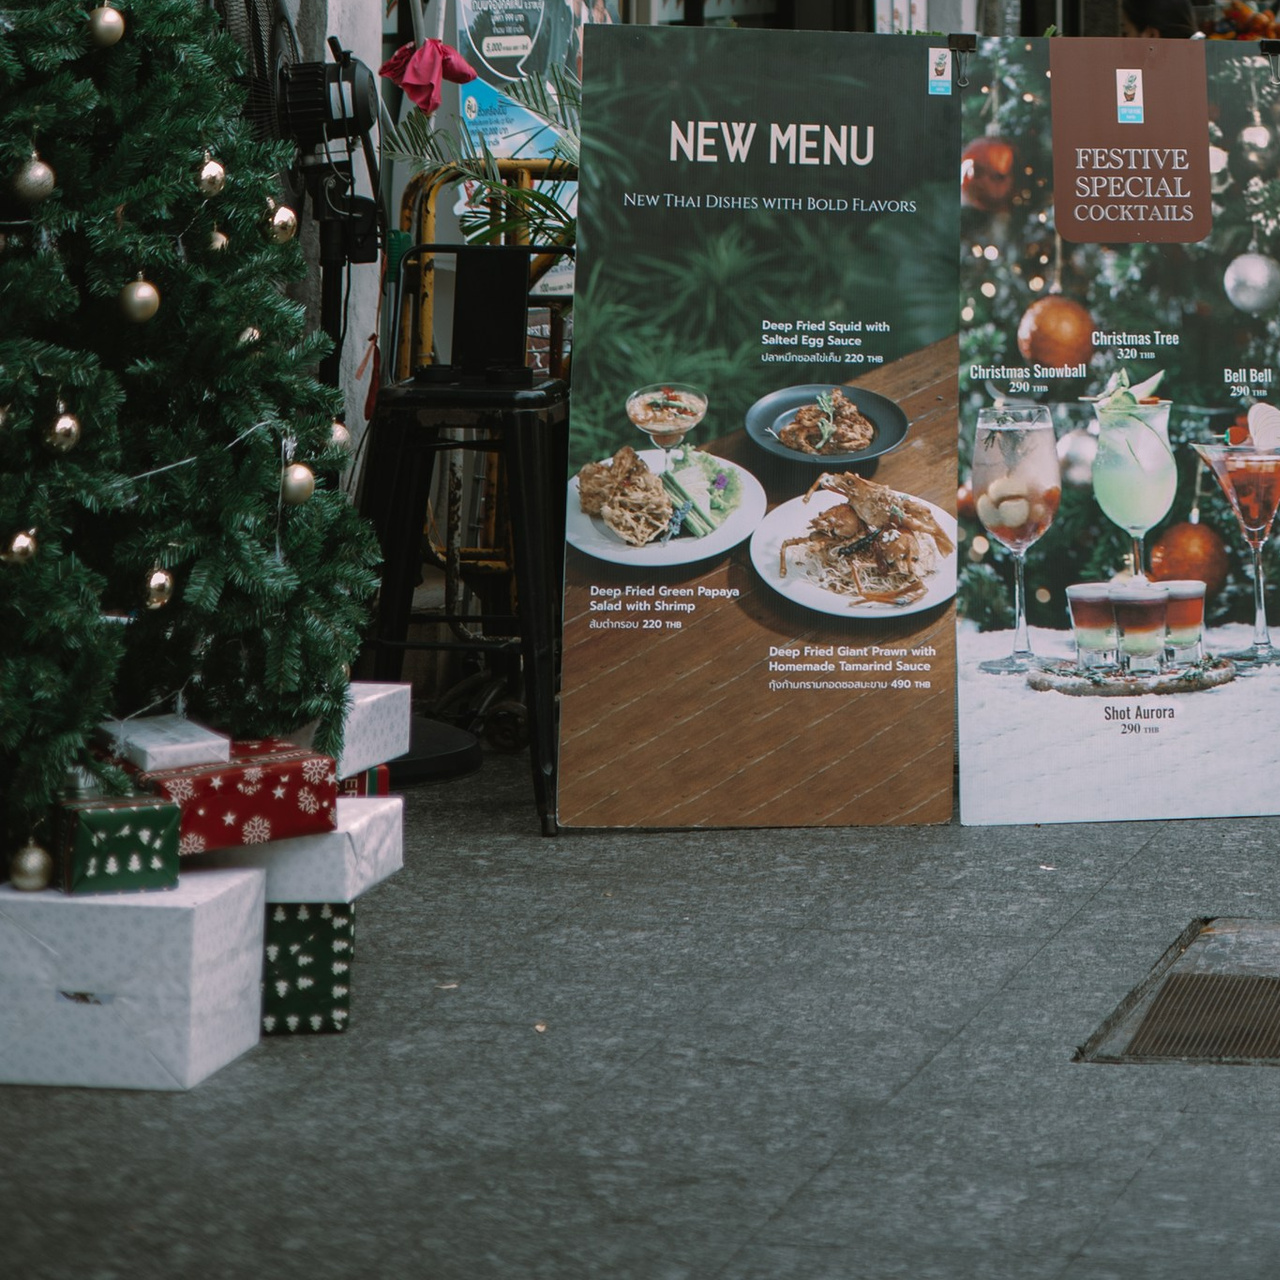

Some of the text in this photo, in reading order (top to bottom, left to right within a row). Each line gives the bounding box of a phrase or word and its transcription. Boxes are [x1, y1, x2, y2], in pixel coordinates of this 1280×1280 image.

[670, 120, 874, 166] NEW MENU
[1075, 148, 1190, 172] FESTIVE
[1075, 175, 1191, 200] SPECIAL
[623, 192, 917, 213] NEW THAI DISHES WITH BOLD FLAVORS
[1074, 203, 1194, 223] COCKTAILS
[762, 320, 890, 334] Deep Fried Squid with
[761, 334, 862, 348] Salted Egg Sauce
[1091, 330, 1179, 346] Christmas Tree
[844, 353, 865, 363] 220
[866, 355, 884, 364] THB
[1116, 348, 1156, 360] 320 THB
[969, 363, 1086, 380] Christmas Snowball
[1223, 368, 1272, 384] Bell Bell
[1008, 380, 1049, 393] 290 THB
[1229, 385, 1268, 397] 290 THB
[590, 585, 740, 599] Deep Fried Green Papaya
[589, 600, 696, 614] Salad with Shrimp
[589, 618, 682, 630] ส้มตำกรอบ 220 THB
[769, 646, 936, 658] Deep Fried Giant Prawn with
[768, 661, 931, 672] Homemade Tamarind Sauce
[890, 679, 912, 689] 490
[914, 680, 931, 689] THB
[1104, 705, 1175, 721] Shot Aurora
[1120, 723, 1160, 734] 290 THB
